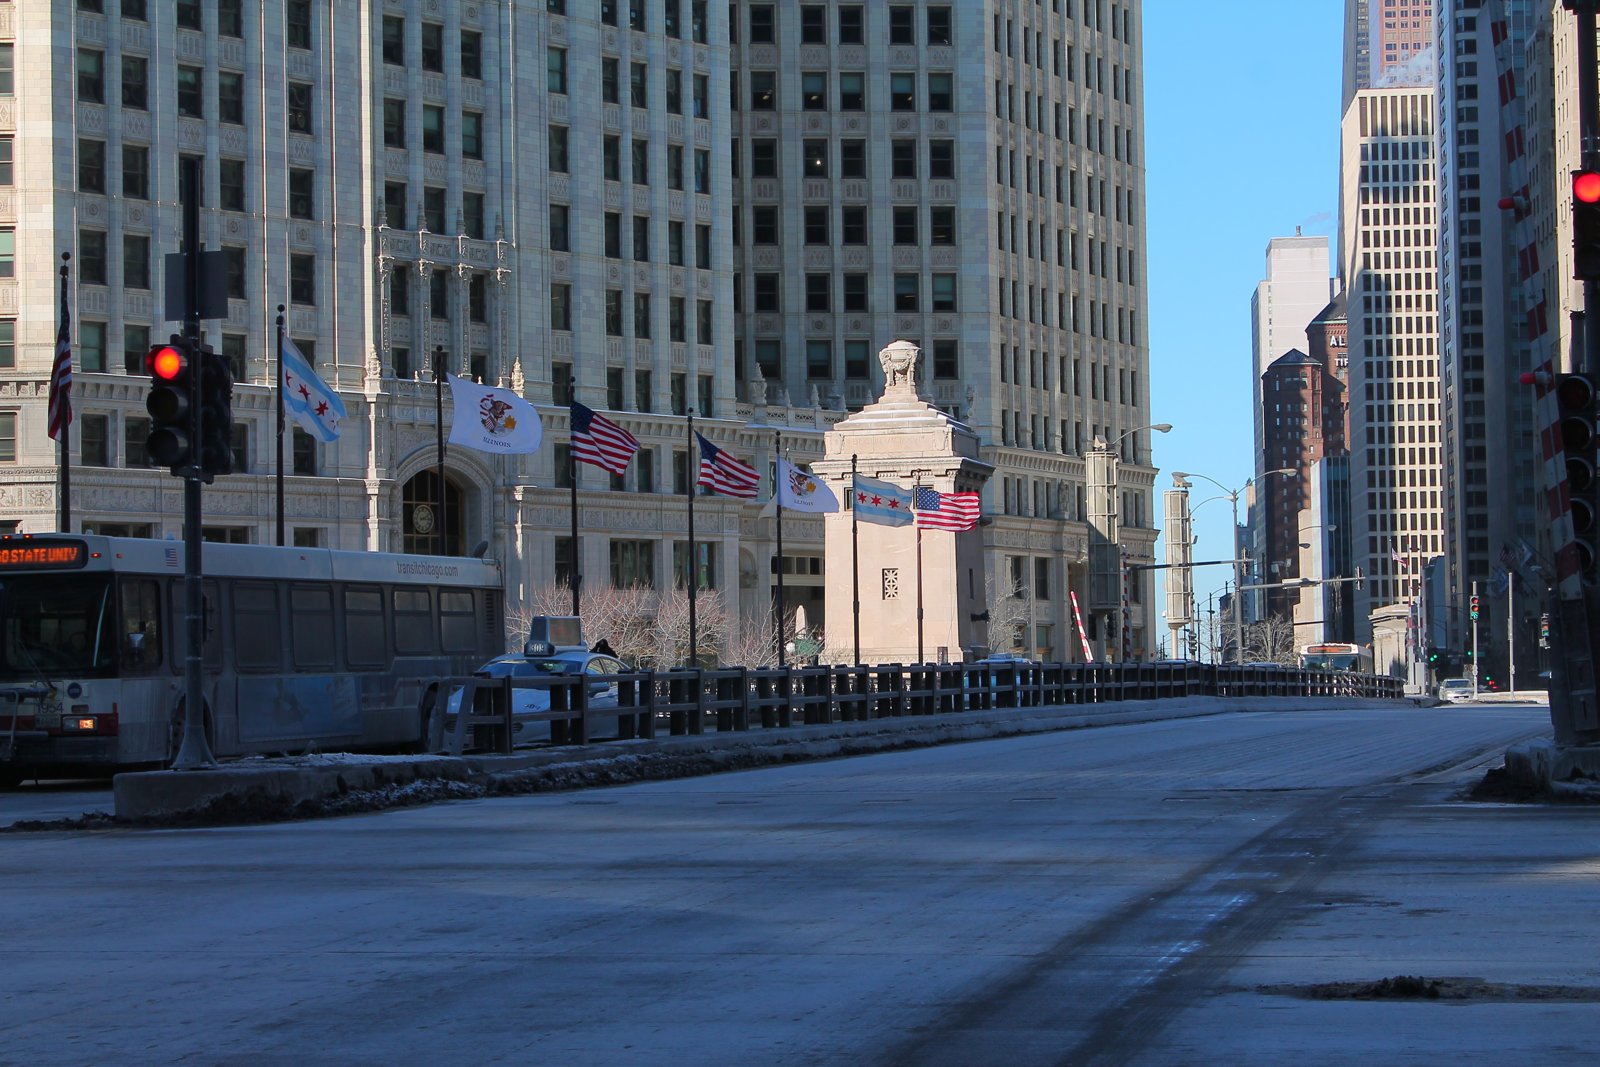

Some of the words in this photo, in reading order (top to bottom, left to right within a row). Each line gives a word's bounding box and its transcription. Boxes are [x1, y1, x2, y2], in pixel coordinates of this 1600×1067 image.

[483, 436, 511, 448] ILLINOIS
[11, 548, 46, 563] STATE
[47, 547, 78, 562] UNIV
[397, 561, 459, 579] transitchicago.com
[37, 702, 64, 713] 1954
